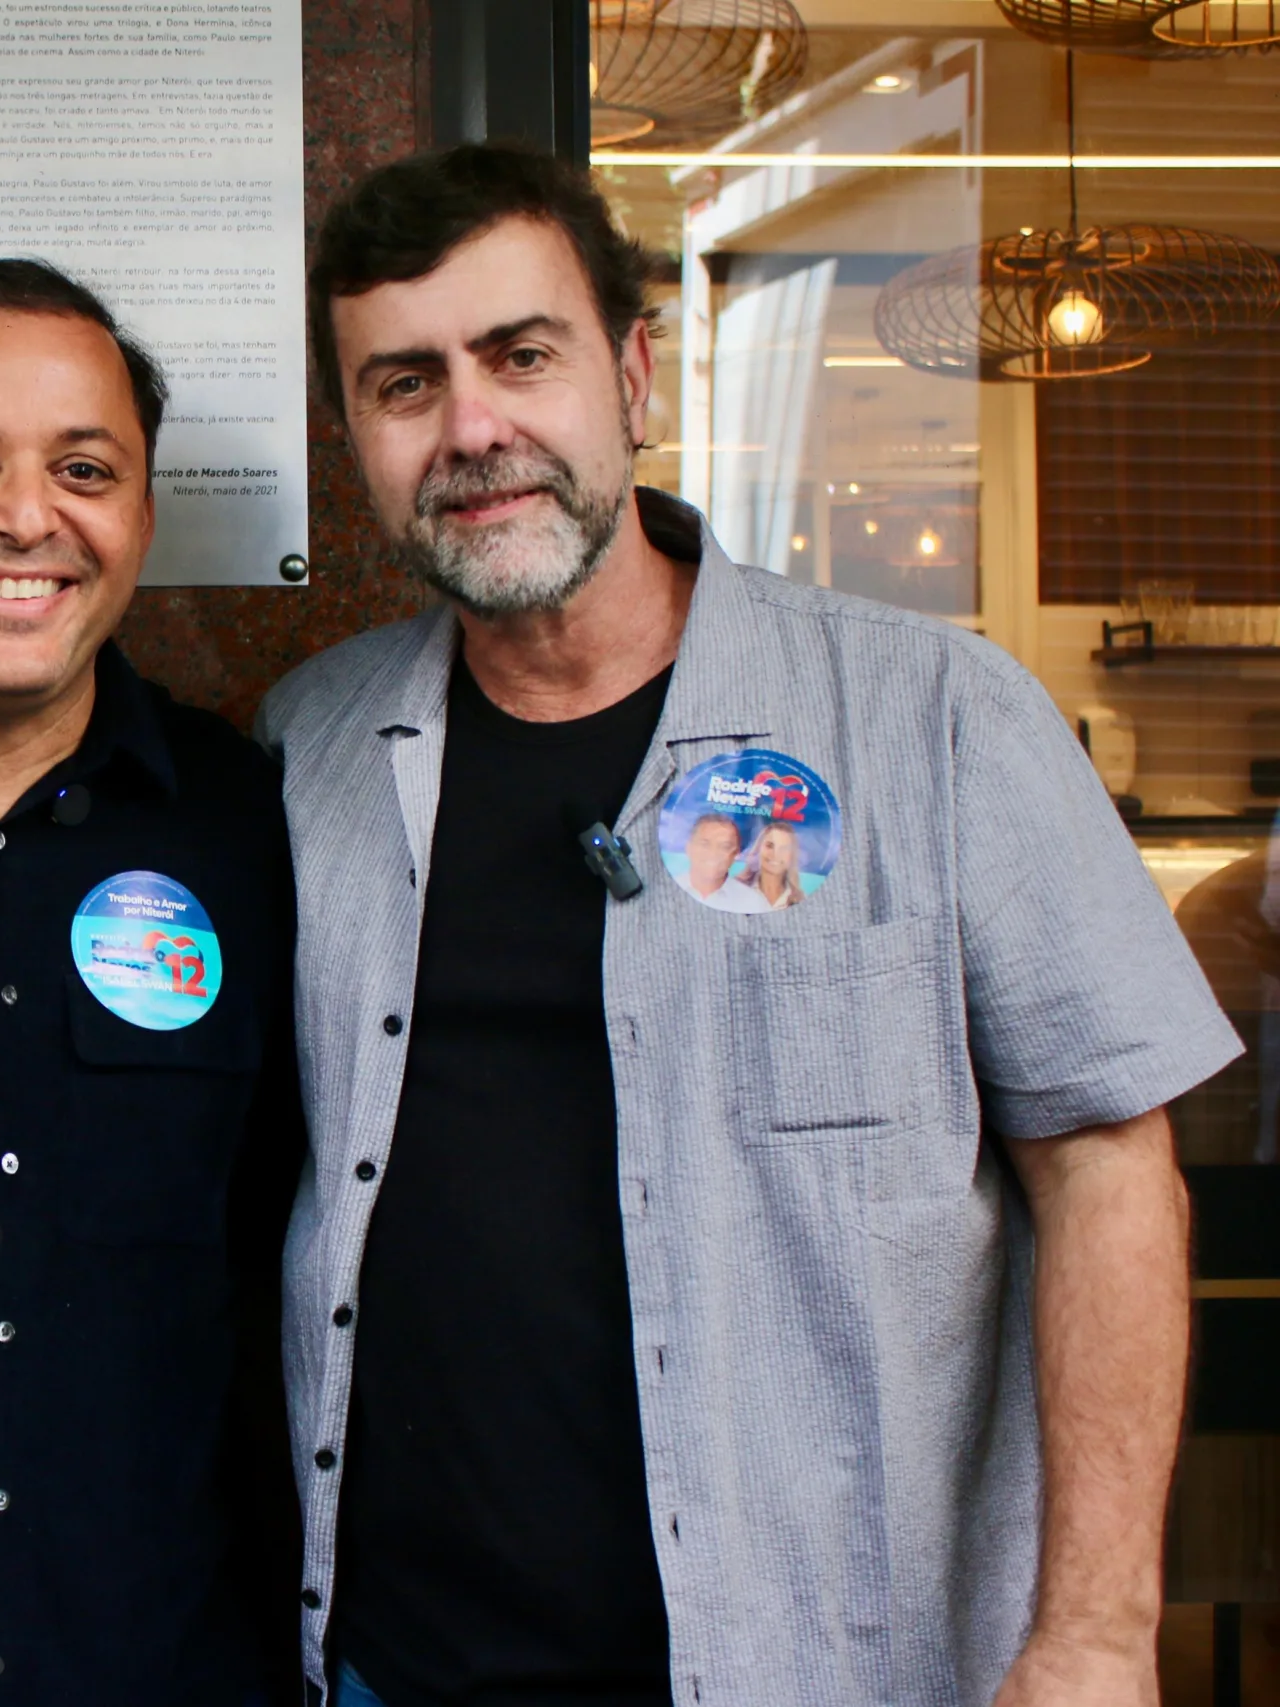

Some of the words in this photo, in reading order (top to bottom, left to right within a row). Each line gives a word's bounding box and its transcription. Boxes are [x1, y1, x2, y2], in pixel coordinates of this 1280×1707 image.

[6, 3, 16, 12] foi
[35, 3, 83, 12] estrondoso
[135, 3, 161, 12] crítica
[207, 3, 239, 12] lotando
[241, 3, 271, 12] teatros
[15, 17, 62, 29] espetáculo
[67, 17, 89, 27] virou
[94, 19, 112, 27] uma
[167, 17, 189, 27] Dona
[19, 34, 35, 42] nas
[39, 32, 80, 42] mulheres
[84, 32, 110, 42] fortes
[128, 34, 143, 42] sua
[183, 34, 207, 42] como
[211, 32, 235, 42] Paulo
[239, 34, 272, 44] sempre
[18, 78, 62, 88] expressou
[66, 78, 81, 86] seu
[85, 76, 114, 88] grande
[118, 78, 140, 86] amor
[144, 78, 158, 88] por
[197, 78, 212, 88] que
[216, 76, 233, 86] teve
[237, 76, 272, 86] diversos
[33, 179, 58, 188] Paulo
[61, 179, 95, 188] Gustavo
[139, 179, 161, 188] Virou
[164, 179, 198, 188] símbolo
[19, 208, 43, 217] Paulo
[47, 208, 81, 217] Gustavo
[84, 208, 94, 217] foi
[97, 208, 132, 217] também
[9, 223, 31, 232] deixa
[55, 223, 83, 234] legado
[89, 223, 118, 232] infinito
[243, 340, 276, 349] tenham
[218, 415, 244, 424] existe
[152, 467, 183, 478] arcelo
[186, 467, 198, 478] de
[201, 467, 240, 478] Macedo
[242, 467, 278, 478] Soares
[173, 485, 210, 497] Niterói,
[213, 485, 237, 496] maio
[240, 485, 252, 496] de
[254, 485, 278, 496] 2021
[707, 788, 757, 807] Neves
[710, 776, 772, 798] Rodrigo
[770, 788, 808, 822] 12
[108, 893, 153, 907] Trabalho
[154, 900, 160, 908] e
[161, 898, 188, 912] Amor
[123, 906, 141, 917] por
[142, 906, 174, 920] Niterói
[164, 953, 207, 998] 12
